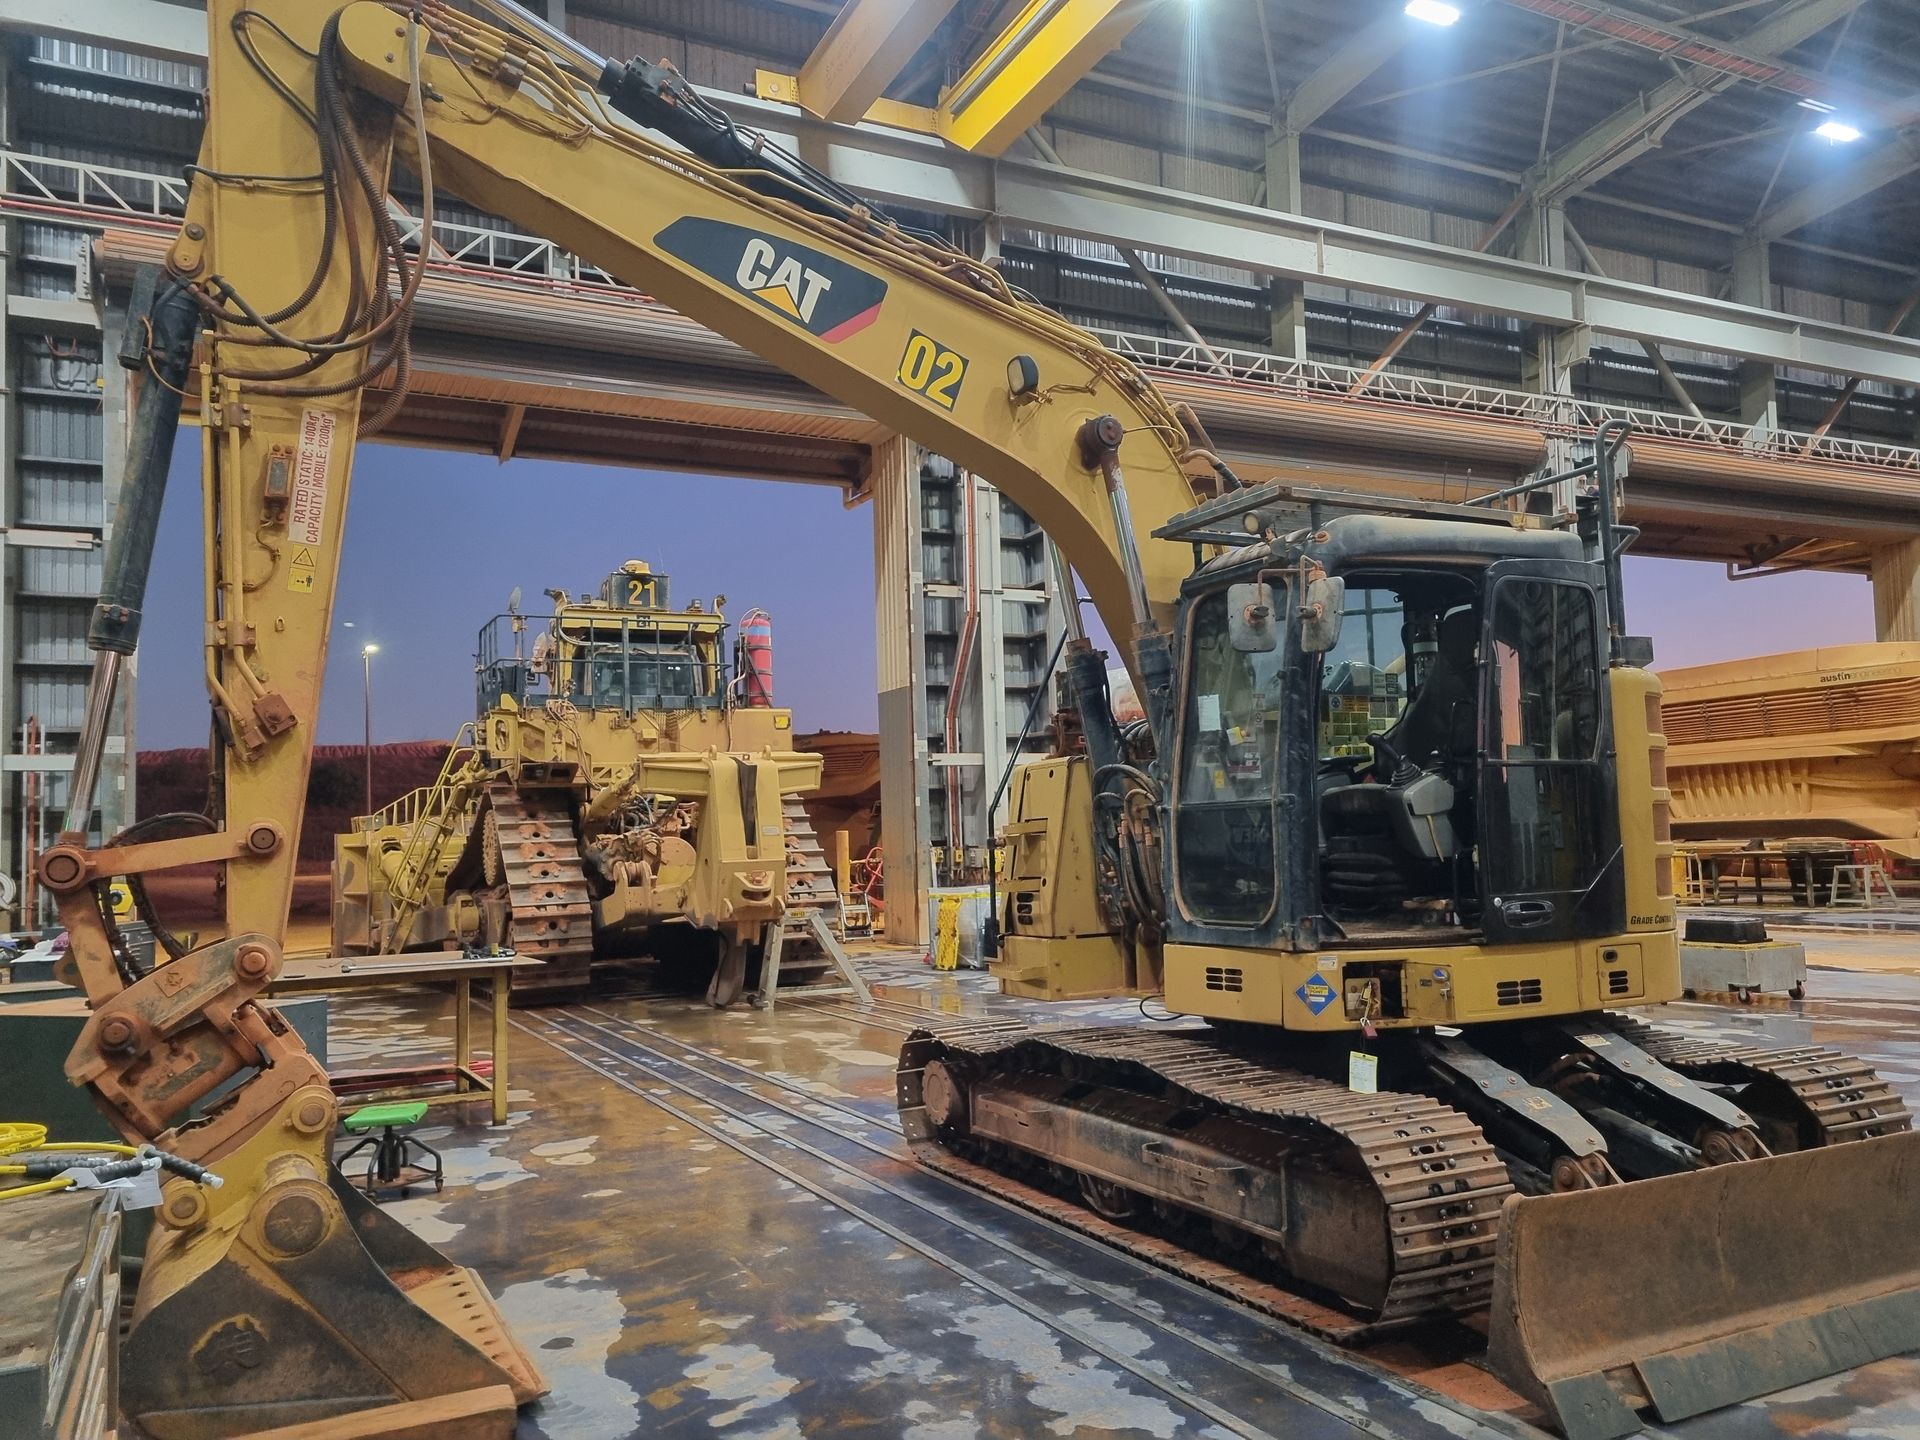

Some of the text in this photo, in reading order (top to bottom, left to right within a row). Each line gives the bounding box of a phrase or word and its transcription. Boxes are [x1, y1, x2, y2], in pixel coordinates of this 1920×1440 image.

[736, 238, 832, 324] CAT
[900, 335, 964, 408] 02
[299, 448, 314, 486] STATIC:
[312, 449, 327, 488] MOBILE:
[294, 490, 309, 524] RATED
[306, 492, 322, 544] CAPACITY
[628, 580, 656, 608] 21
